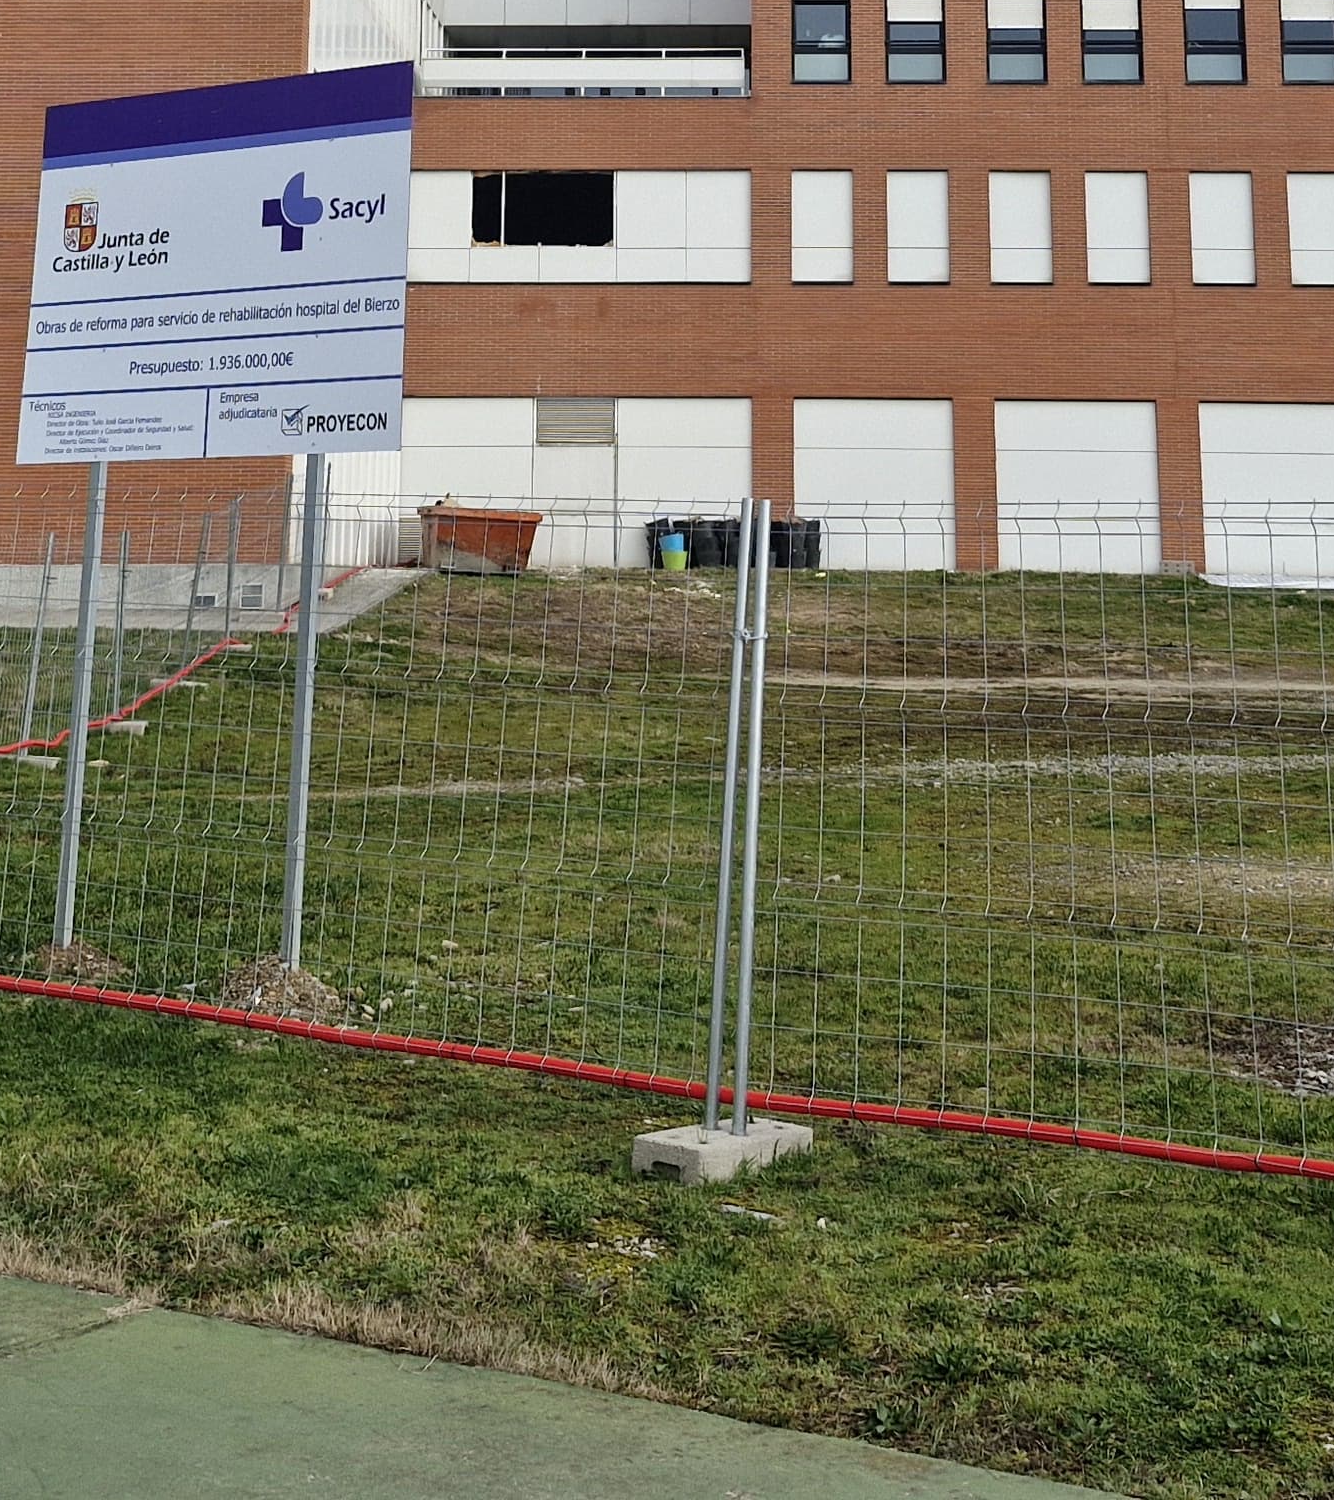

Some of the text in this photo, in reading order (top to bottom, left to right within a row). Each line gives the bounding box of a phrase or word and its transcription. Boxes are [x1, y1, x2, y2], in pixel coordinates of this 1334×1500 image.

[328, 193, 385, 223] Sacyl
[97, 228, 170, 249] Junta de
[52, 249, 168, 273] Castilla y León
[36, 296, 400, 335] Obras de reforma para servicio de rehabilitación hospital del Bierzo
[129, 351, 294, 376] Presupuesto: 1.936.000,00€
[29, 401, 66, 412] Técnicos
[219, 391, 259, 405] Empresa
[219, 405, 278, 421] adjudicataria
[306, 412, 388, 433] PROYECON
